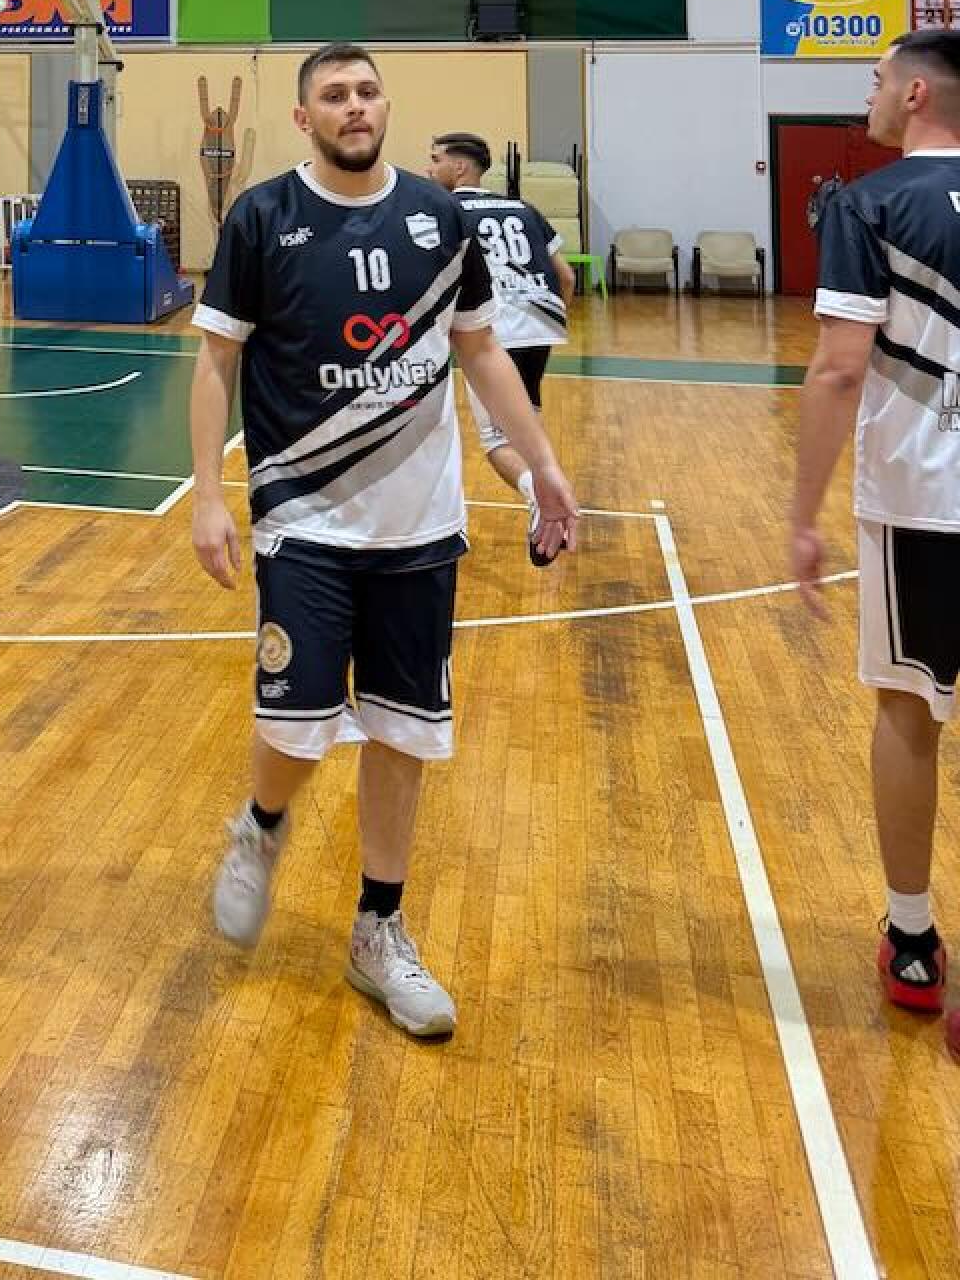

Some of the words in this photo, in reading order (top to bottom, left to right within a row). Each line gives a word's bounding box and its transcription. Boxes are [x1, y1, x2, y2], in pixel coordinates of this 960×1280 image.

[801, 15, 881, 37] 10300
[478, 216, 531, 265] 36
[348, 247, 391, 292] 10
[319, 358, 437, 394] OnlyNet
